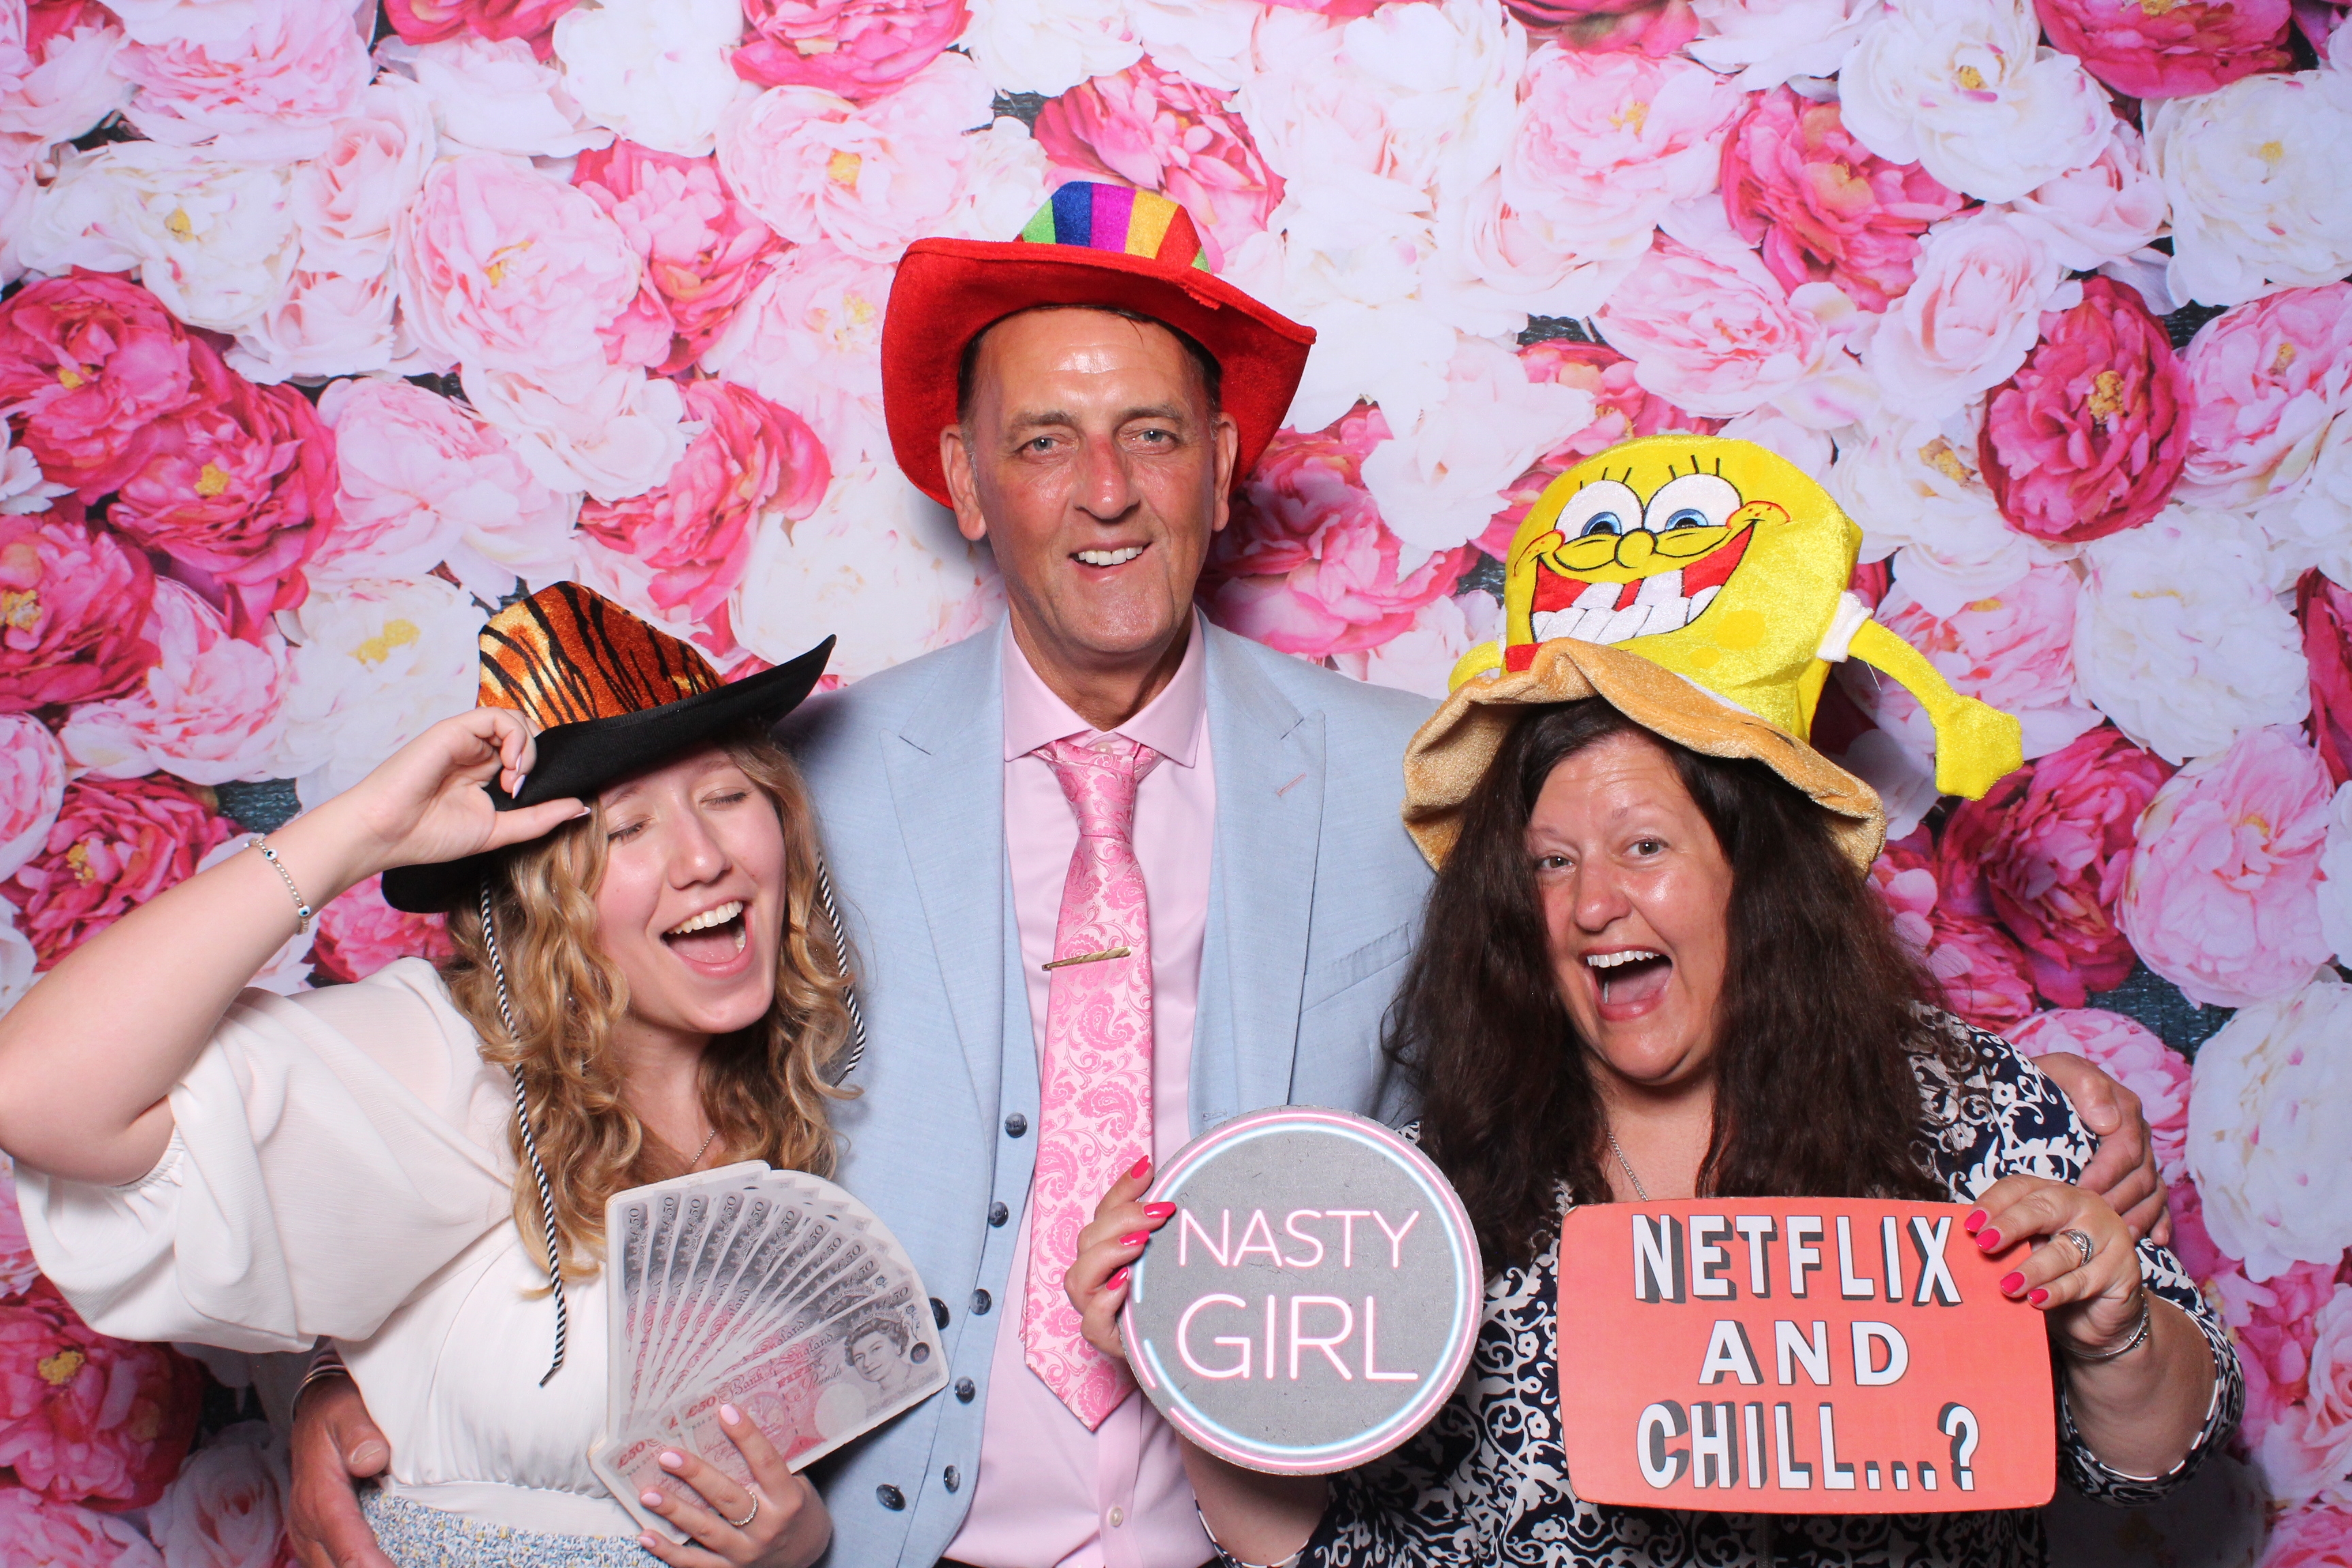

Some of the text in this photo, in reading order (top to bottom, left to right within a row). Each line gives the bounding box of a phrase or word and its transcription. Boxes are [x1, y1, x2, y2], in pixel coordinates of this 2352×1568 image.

[662, 1197, 674, 1225] £50
[687, 1199, 701, 1227] £50
[721, 1196, 736, 1226] £50
[747, 1201, 764, 1230] £50
[776, 1211, 795, 1239] £50
[818, 1237, 841, 1265] £50
[1179, 1209, 1420, 1269] NASTY
[837, 1245, 860, 1273] £50
[850, 1260, 874, 1283] £50
[1631, 1214, 1963, 1307] NETFLIX
[1177, 1293, 1419, 1380] GIRL
[719, 1369, 764, 1401] Bank
[780, 1332, 834, 1360] England
[1697, 1320, 1909, 1386] AND
[777, 1357, 823, 1388] FIFTY
[786, 1364, 842, 1402] Pounds
[685, 1396, 716, 1420] £50
[618, 1441, 646, 1470] £50
